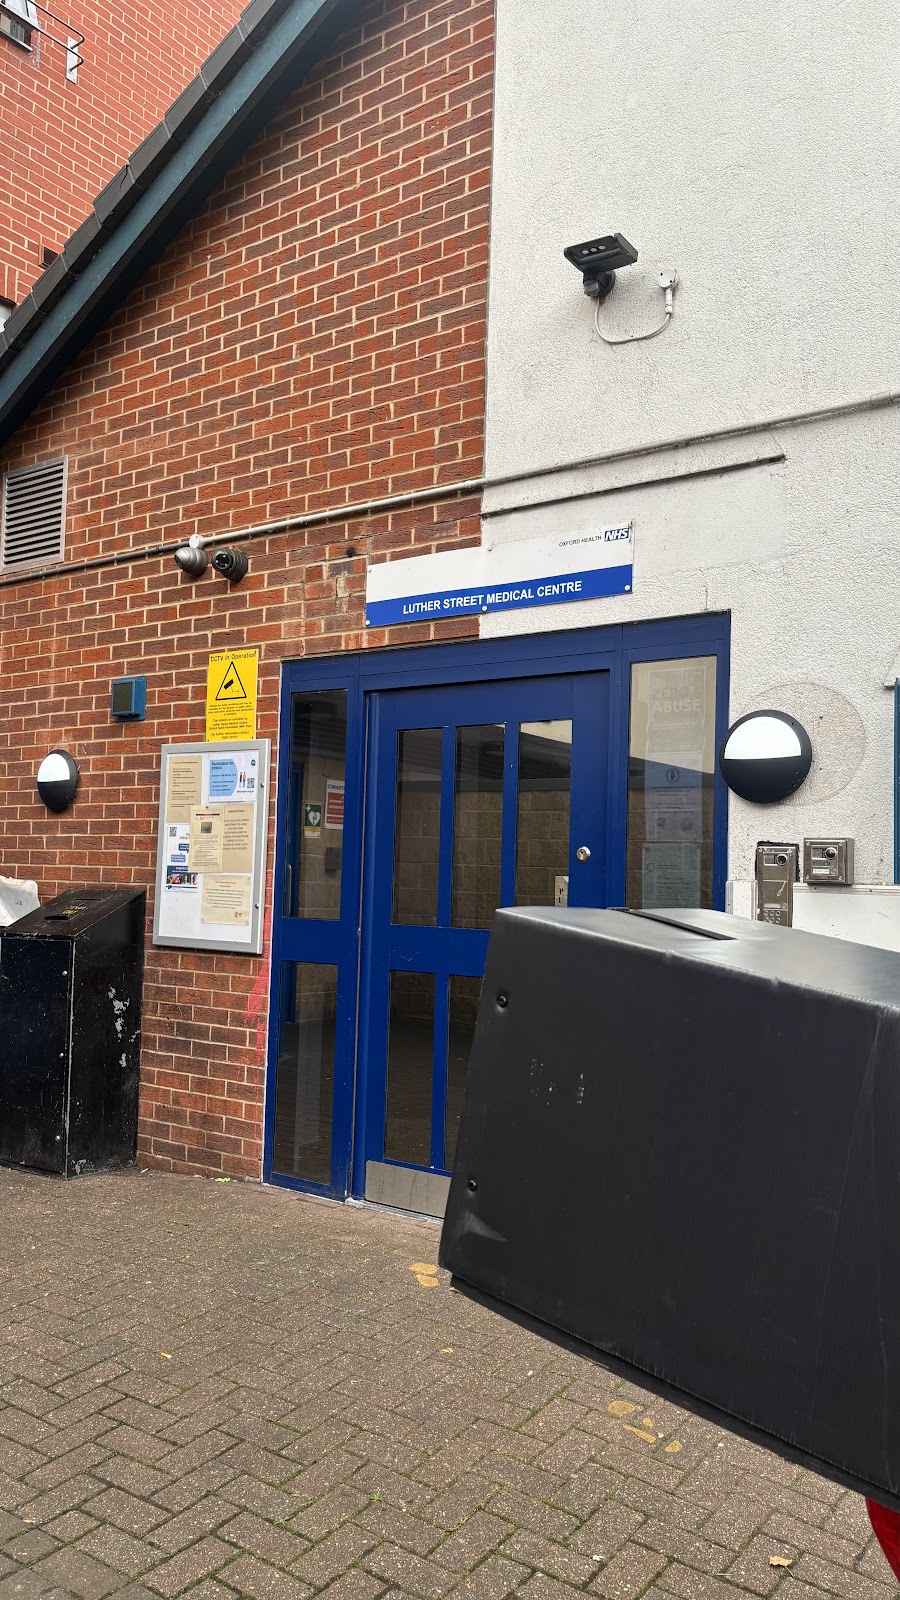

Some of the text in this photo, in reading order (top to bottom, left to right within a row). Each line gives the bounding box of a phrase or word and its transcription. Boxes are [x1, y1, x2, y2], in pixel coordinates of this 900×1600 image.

[558, 539, 580, 547] OXFORD
[605, 528, 628, 541] NHS
[403, 580, 582, 614] LUTHER STREET MEDICAL CENTRE
[231, 652, 256, 660] Operation
[652, 687, 689, 699] ZERO
[654, 699, 701, 713] ABUSE
